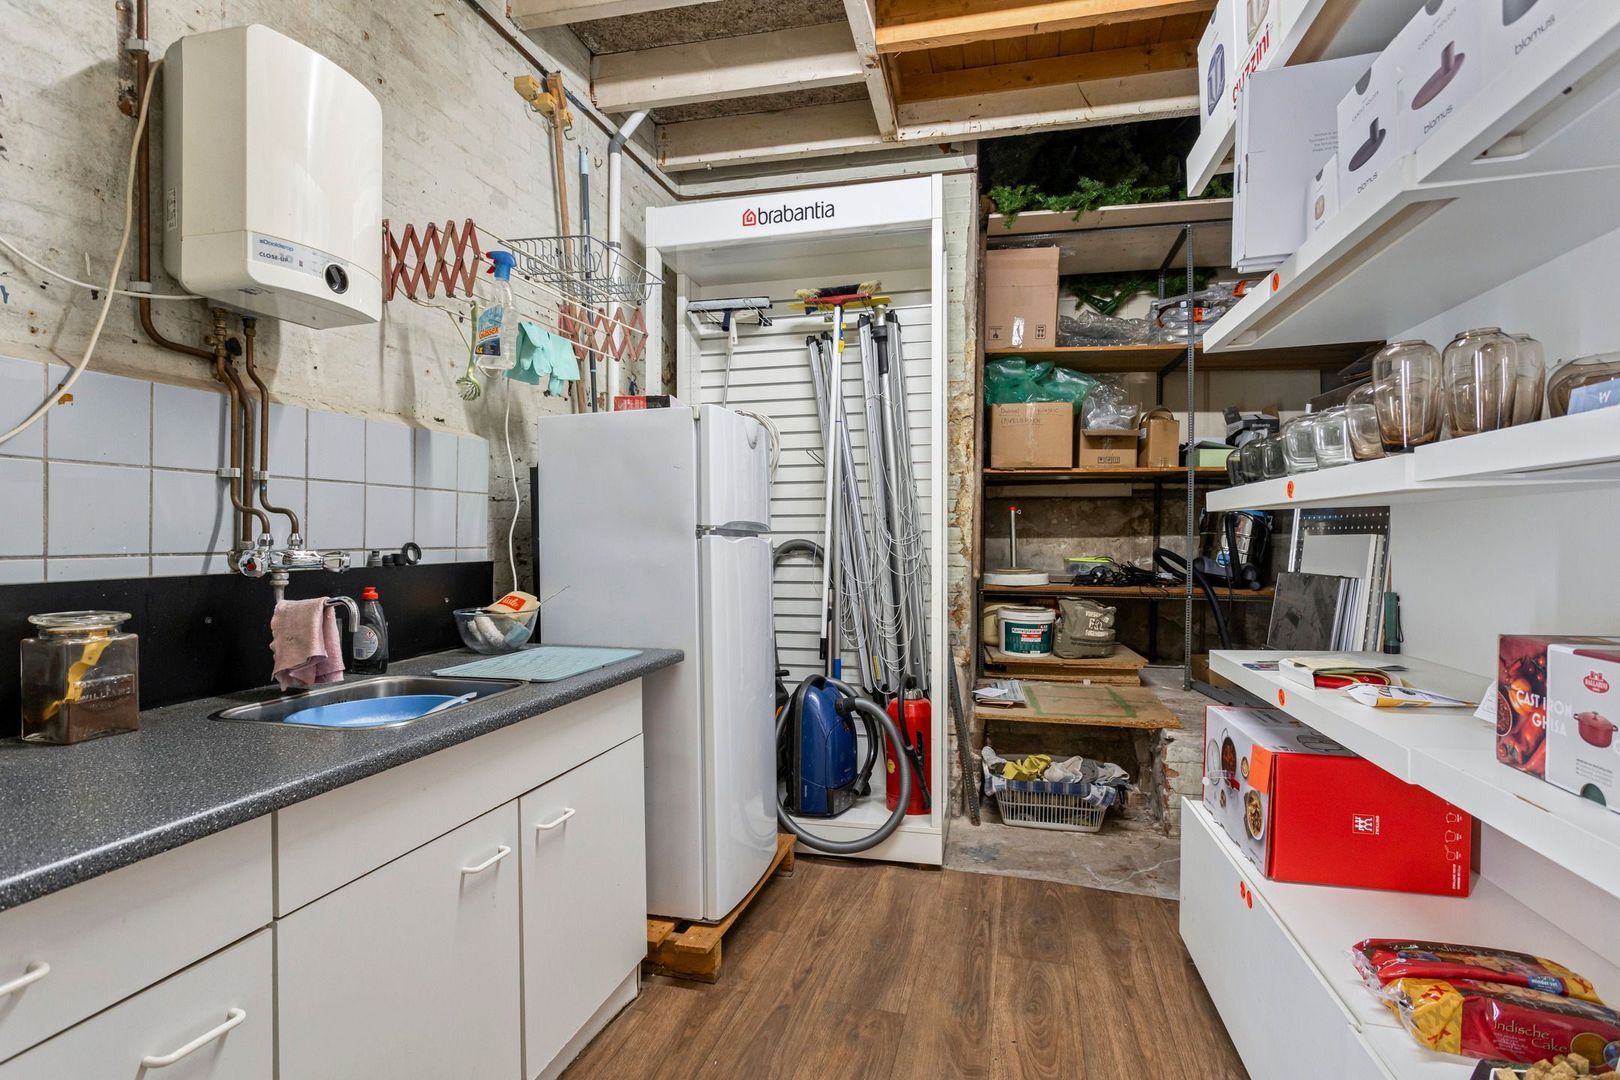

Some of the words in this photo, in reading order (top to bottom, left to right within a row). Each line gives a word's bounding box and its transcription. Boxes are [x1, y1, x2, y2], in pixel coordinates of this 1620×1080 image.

[757, 200, 835, 225] brabantia
[1516, 689, 1541, 708] CAST
[1531, 712, 1567, 737] GHISA
[1493, 1018, 1550, 1040] Indische
[1531, 1037, 1570, 1052] Cake
